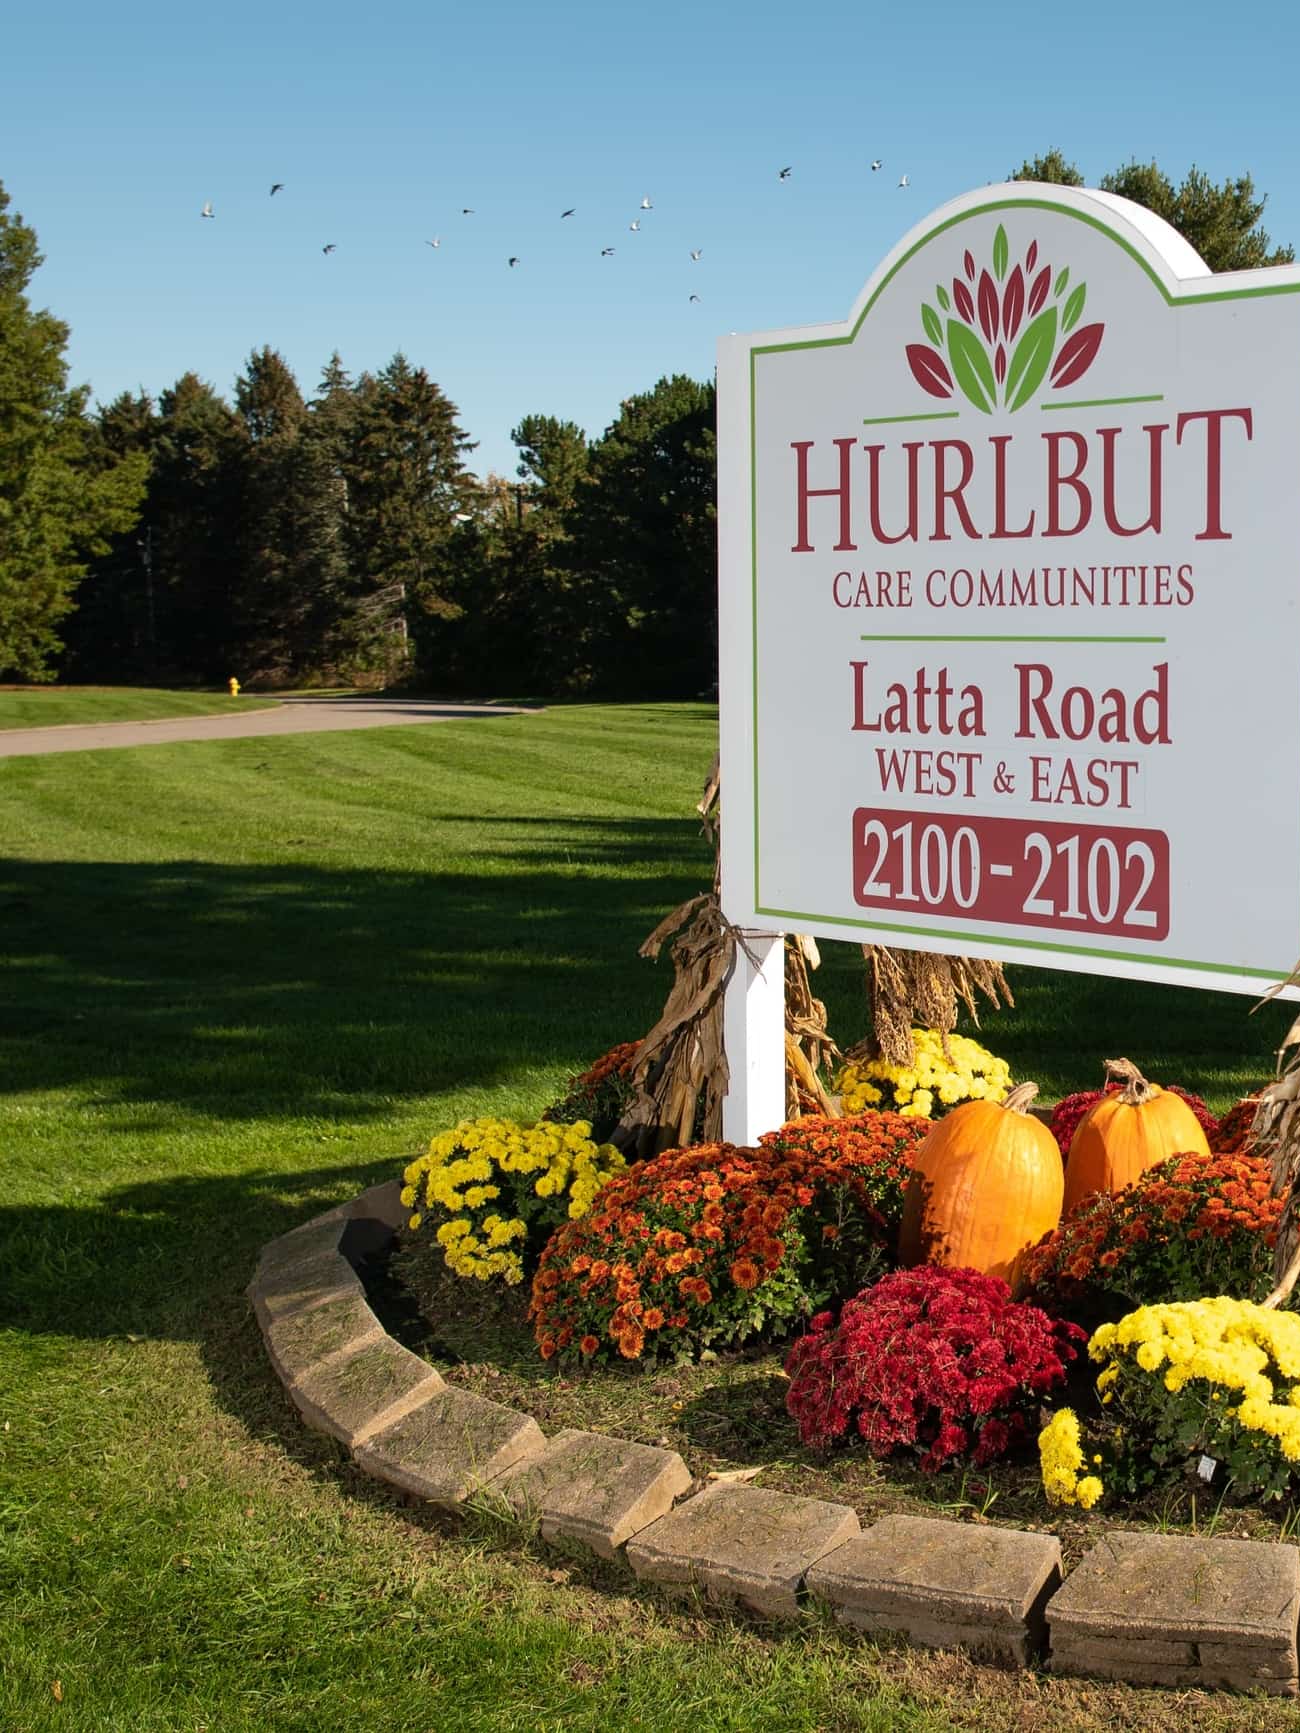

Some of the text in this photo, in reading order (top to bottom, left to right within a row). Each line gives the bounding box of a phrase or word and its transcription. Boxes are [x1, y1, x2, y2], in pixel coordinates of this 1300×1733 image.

[790, 407, 1253, 553] HURLBUT
[832, 564, 1195, 608] CARE COMMUNITIES
[850, 661, 1172, 745] Latta Road
[875, 748, 1139, 808] WEST & EAST
